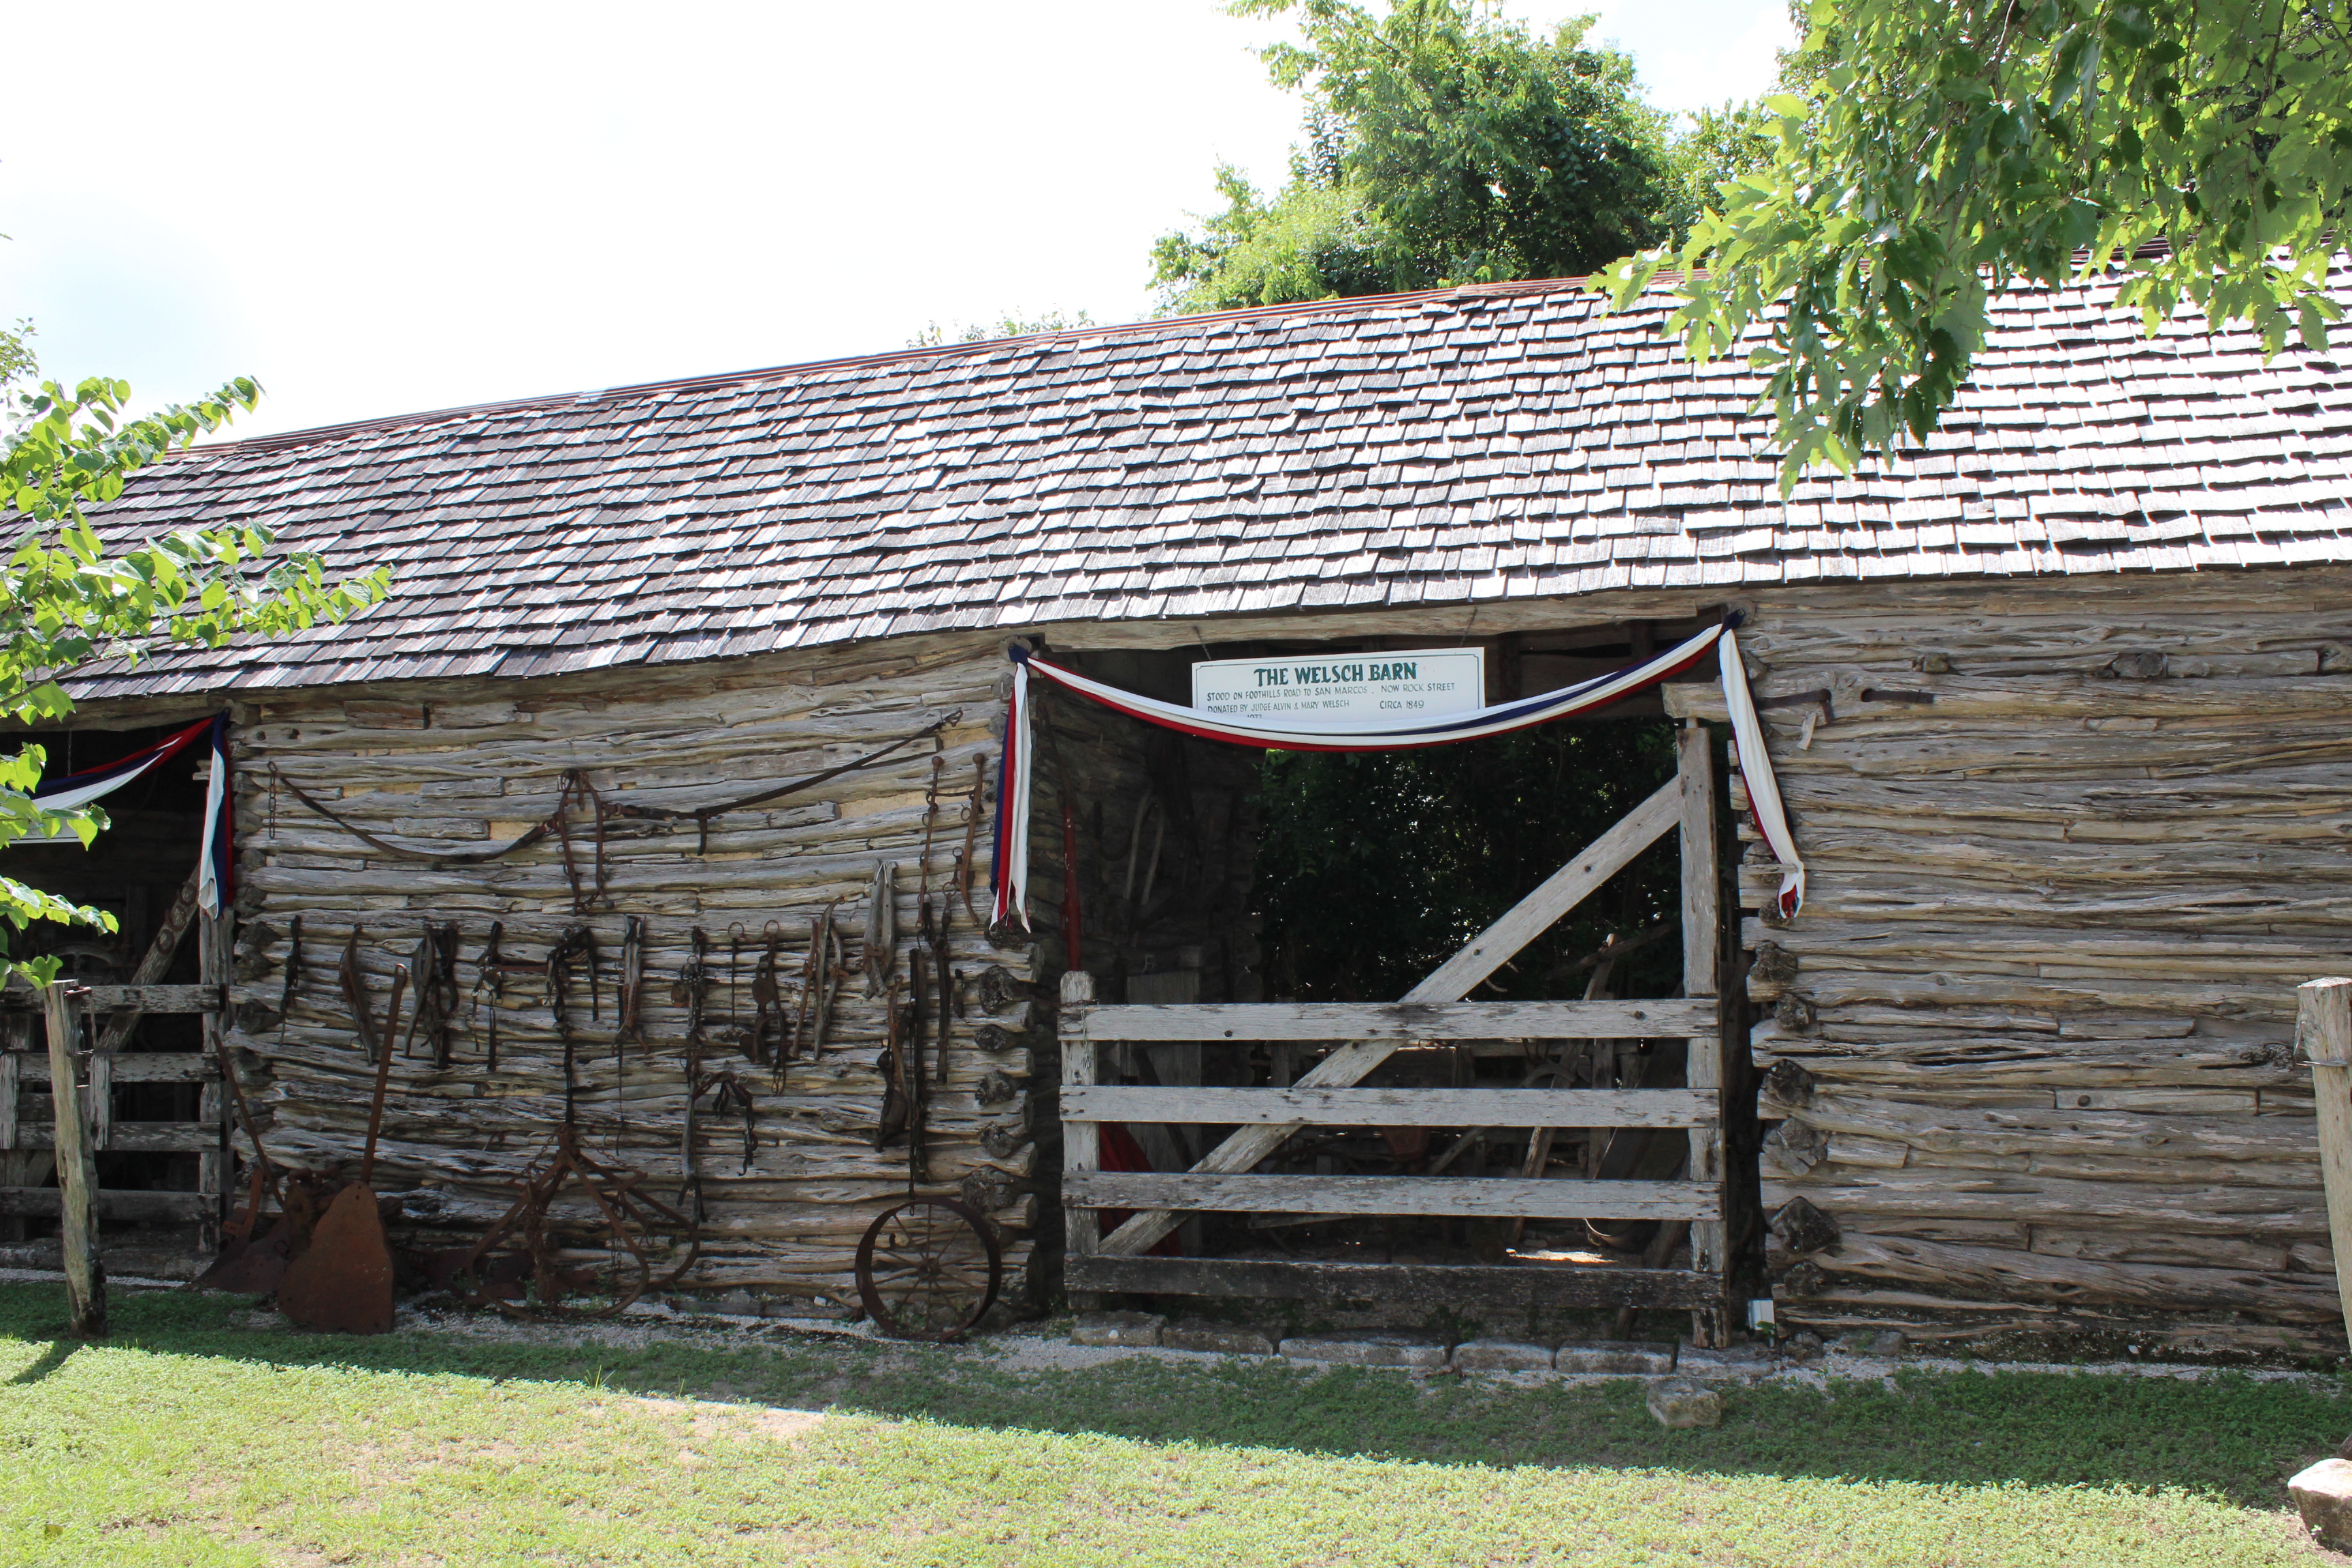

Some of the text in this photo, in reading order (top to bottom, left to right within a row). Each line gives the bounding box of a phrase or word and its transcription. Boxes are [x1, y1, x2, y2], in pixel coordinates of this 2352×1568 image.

[1254, 662, 1418, 687] THE WELSCH BARN
[1207, 692, 1230, 702] STOOD
[1233, 691, 1243, 700] ON
[1245, 689, 1281, 700] FOOTHILLS
[1284, 689, 1301, 698] ROAD
[1315, 687, 1331, 696] SAN
[1381, 684, 1400, 693] NOW
[1403, 683, 1424, 692] ROCK
[1427, 683, 1455, 691] STREET
[1207, 704, 1237, 713] DONATED
[1240, 704, 1248, 712] BY
[1251, 702, 1271, 712] JUDGE
[1273, 702, 1291, 710] ALVIN
[1301, 701, 1319, 709] MARY
[1322, 700, 1350, 708] WELSCH
[1379, 700, 1424, 709] CIRCA 1849
